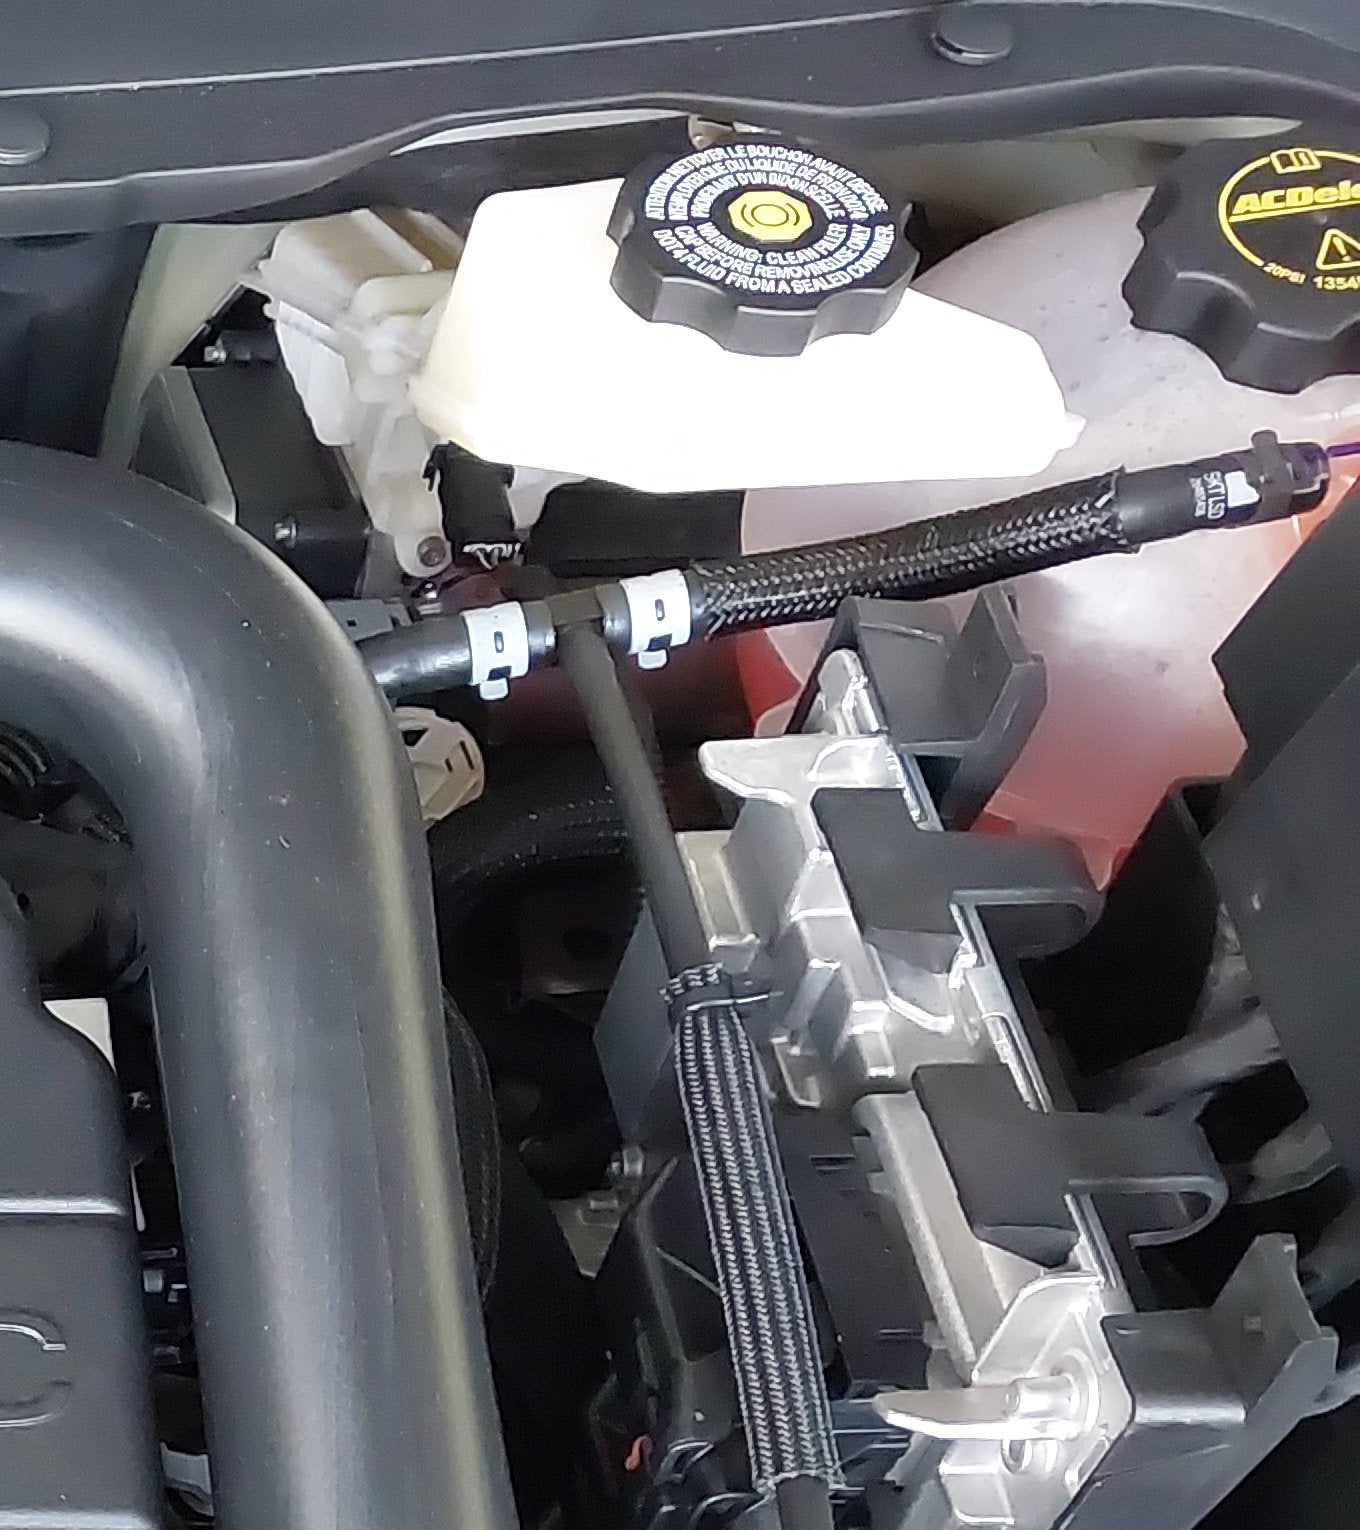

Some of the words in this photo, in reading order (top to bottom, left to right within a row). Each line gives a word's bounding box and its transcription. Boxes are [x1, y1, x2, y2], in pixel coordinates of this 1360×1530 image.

[699, 161, 729, 181] QUE
[725, 158, 746, 173] DU
[745, 158, 798, 175] LIQUIDE
[795, 165, 818, 181] DE
[726, 145, 747, 158] LE
[747, 145, 814, 165] BOUCHON
[809, 157, 857, 182] AVANT
[674, 225, 705, 246] CAP
[694, 243, 755, 276] BEFORE
[696, 221, 763, 262] WARNING:
[765, 247, 820, 265] CLEAN
[679, 253, 727, 281] FLUID
[725, 272, 776, 292] FROM
[776, 280, 791, 294] A
[791, 271, 853, 294] SEALED
